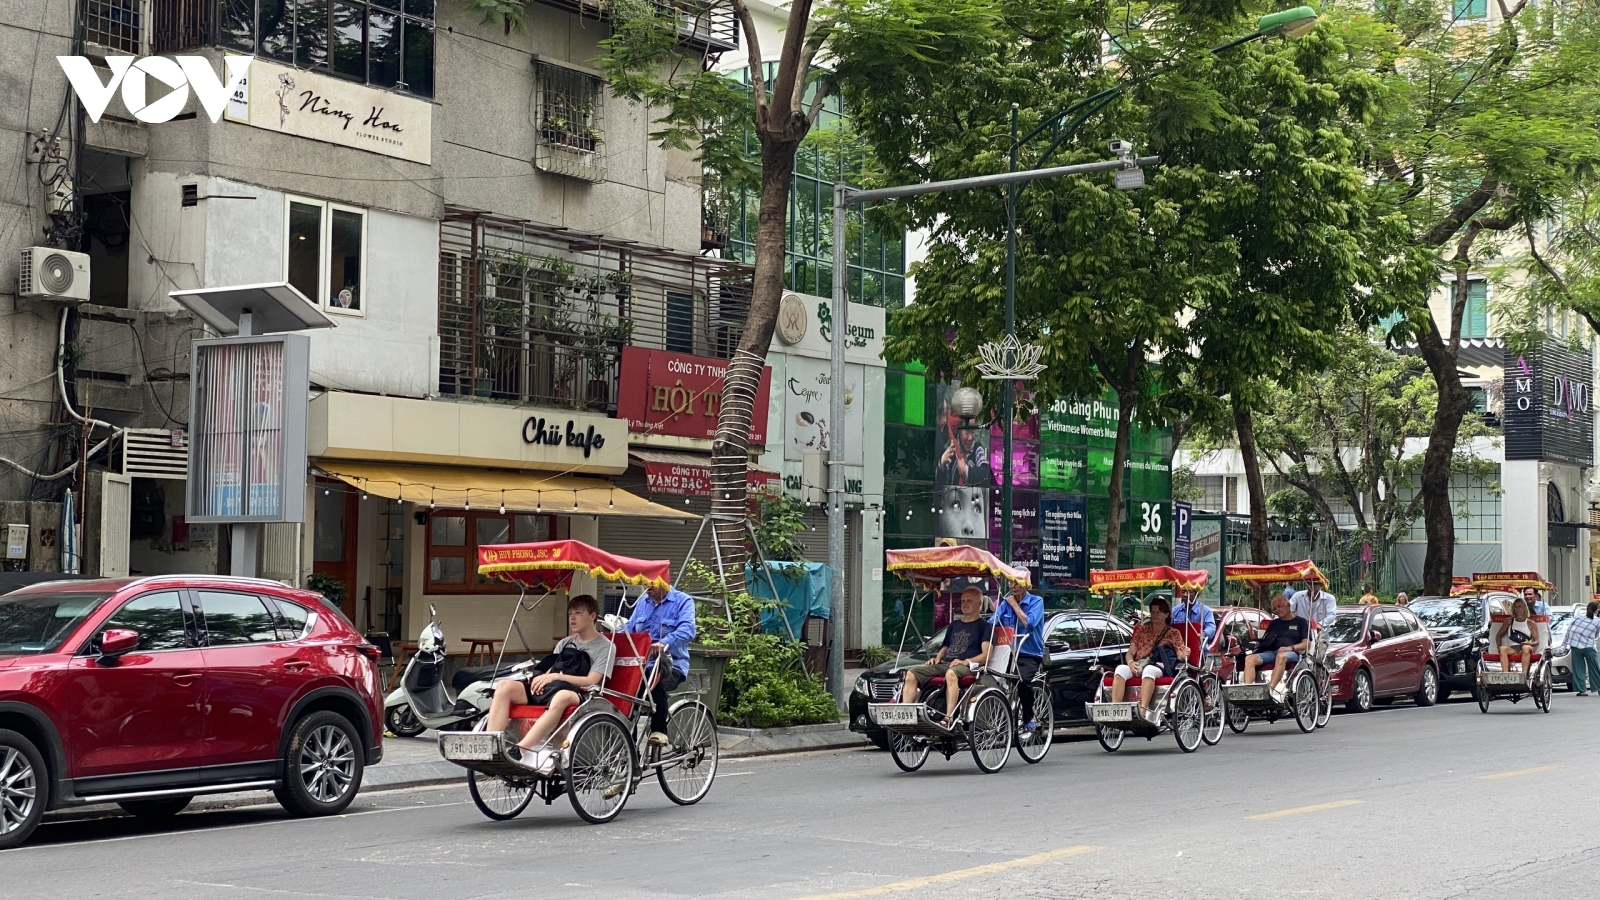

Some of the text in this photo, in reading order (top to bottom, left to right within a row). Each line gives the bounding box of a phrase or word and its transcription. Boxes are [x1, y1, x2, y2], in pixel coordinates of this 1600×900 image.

[299, 90, 404, 132] Nàng Hoa
[668, 358, 692, 374] CÔNG
[694, 364, 705, 376] TY
[651, 378, 721, 421] HỘI T
[1093, 400, 1111, 425] Phụ
[522, 416, 605, 458] Chii kafe
[1048, 420, 1080, 434] Vietnamese
[1080, 424, 1104, 437] Women's
[671, 465, 711, 479] CÔNG TY TN
[1145, 461, 1150, 470] du
[1151, 461, 1169, 472] Vietnam
[647, 472, 679, 488] VÀNG
[681, 479, 702, 491] BẠC
[1011, 509, 1022, 519] rong
[1140, 502, 1161, 533] 36
[1179, 508, 1188, 535] P
[1195, 534, 1219, 550] CEILING
[499, 550, 510, 559] HUY
[552, 548, 561, 558] 30
